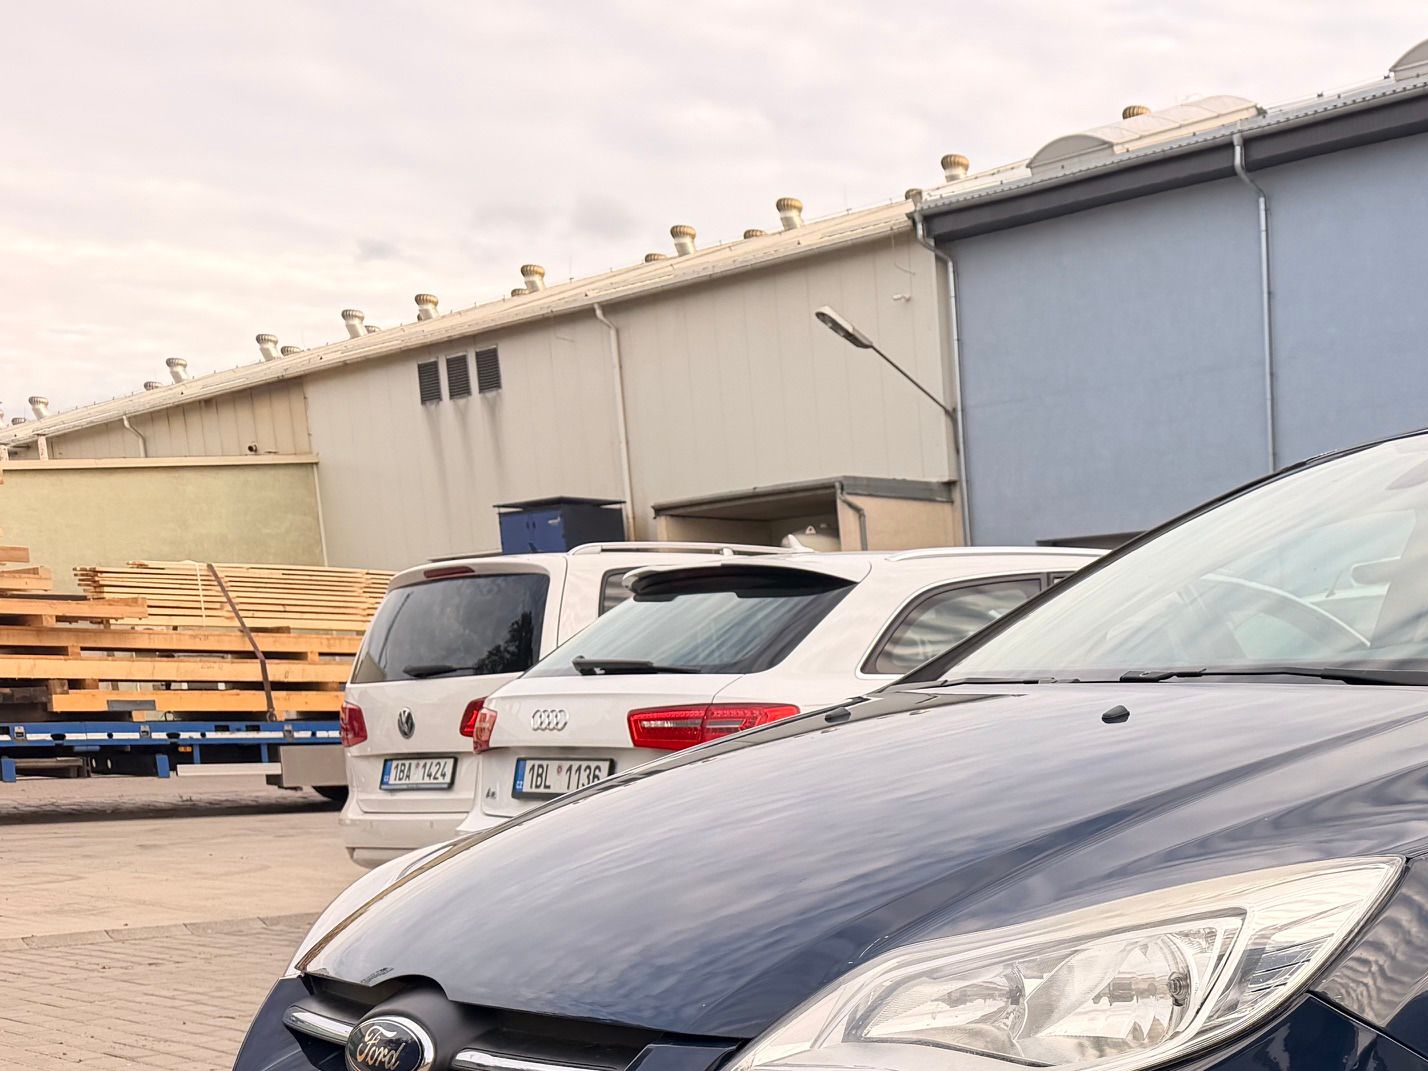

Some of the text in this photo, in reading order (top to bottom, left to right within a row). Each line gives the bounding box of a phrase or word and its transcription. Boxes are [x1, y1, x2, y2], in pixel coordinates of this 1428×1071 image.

[394, 761, 447, 781] 1BA 1424
[528, 763, 551, 789] 1BL
[356, 1025, 406, 1071] Ford
